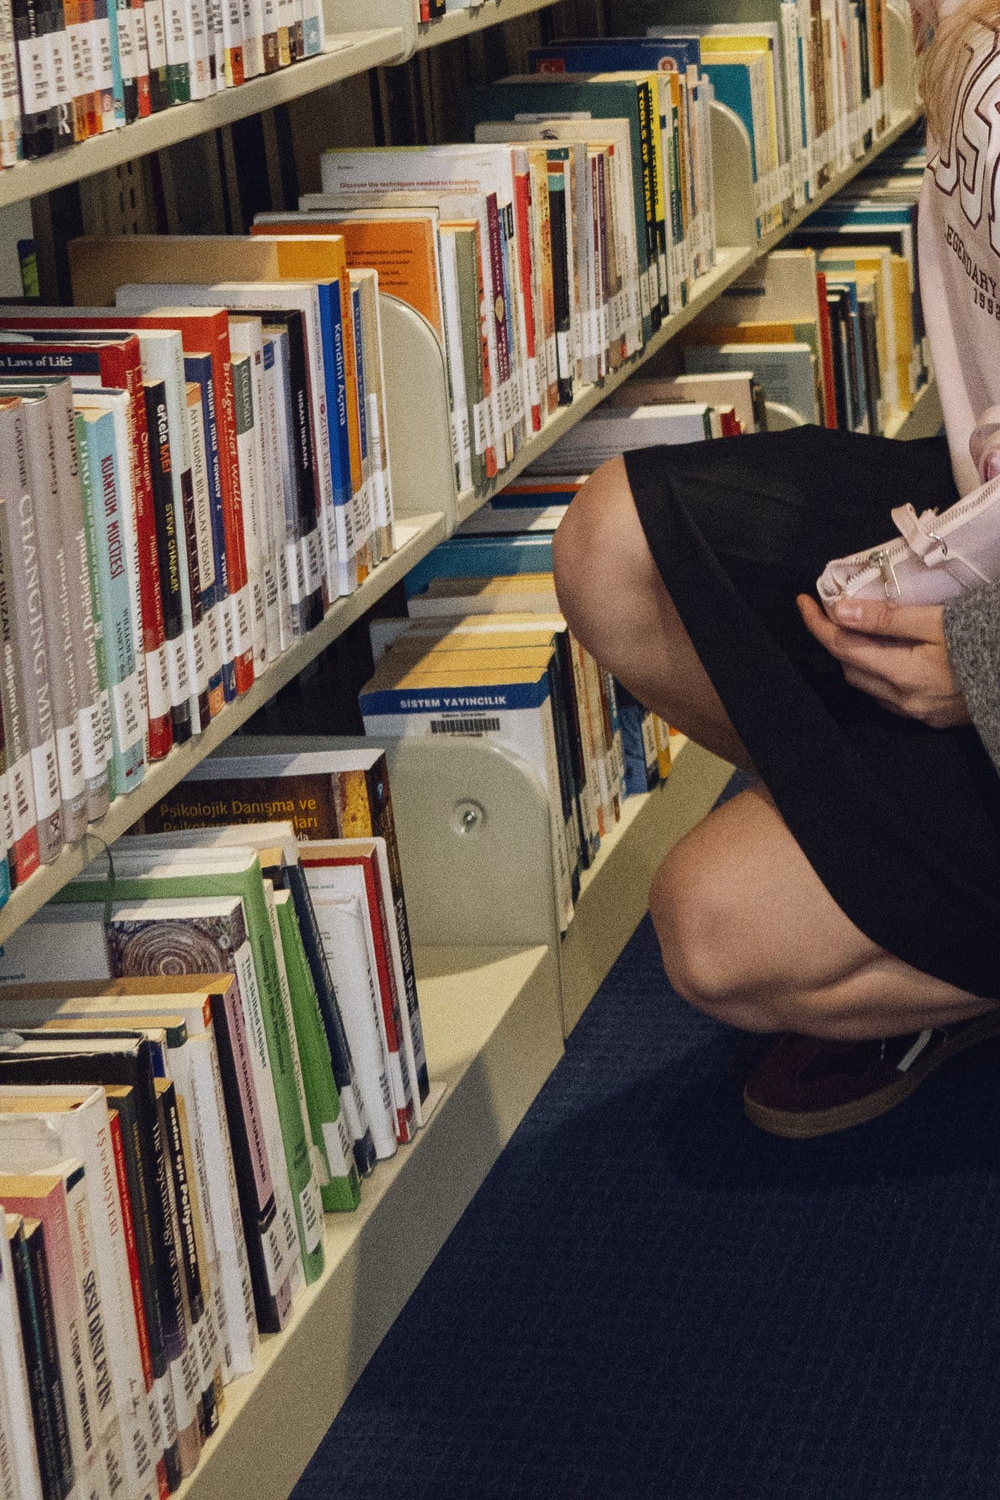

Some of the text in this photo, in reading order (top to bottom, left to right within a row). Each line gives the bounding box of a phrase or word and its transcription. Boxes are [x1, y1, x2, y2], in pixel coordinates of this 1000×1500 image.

[637, 89, 653, 221] TOOLS OF TITANS
[7, 357, 33, 368] Laws
[36, 356, 47, 368] of
[49, 356, 73, 368] Life?
[333, 323, 347, 425] Kendini Açma
[45, 423, 59, 494] Gardner
[63, 406, 80, 476] Gardner
[139, 432, 153, 491] Strategies
[219, 362, 240, 509] Bridges Not Walls
[296, 389, 309, 469] İNSAN İNSANA
[99, 454, 125, 579] KUANTUM MUCİZESİ
[164, 502, 174, 535] STEVE
[189, 409, 211, 582] AH KENDİME BİR KULAK VERSEM!
[13, 417, 53, 742] GARDNER CHANGING MIN
[4, 644, 17, 712] değişimi
[11, 716, 22, 762] kuca
[400, 695, 507, 709] SİSTEM YAYINCILIK
[160, 799, 316, 818] Psikolojik Danışma ve
[394, 898, 411, 971] Psikolojik
[243, 956, 267, 1069] The Skilled Helper
[168, 1106, 180, 1150] madem
[150, 1121, 182, 1295] The Psychology of the
[81, 1269, 99, 1314] SESİ
